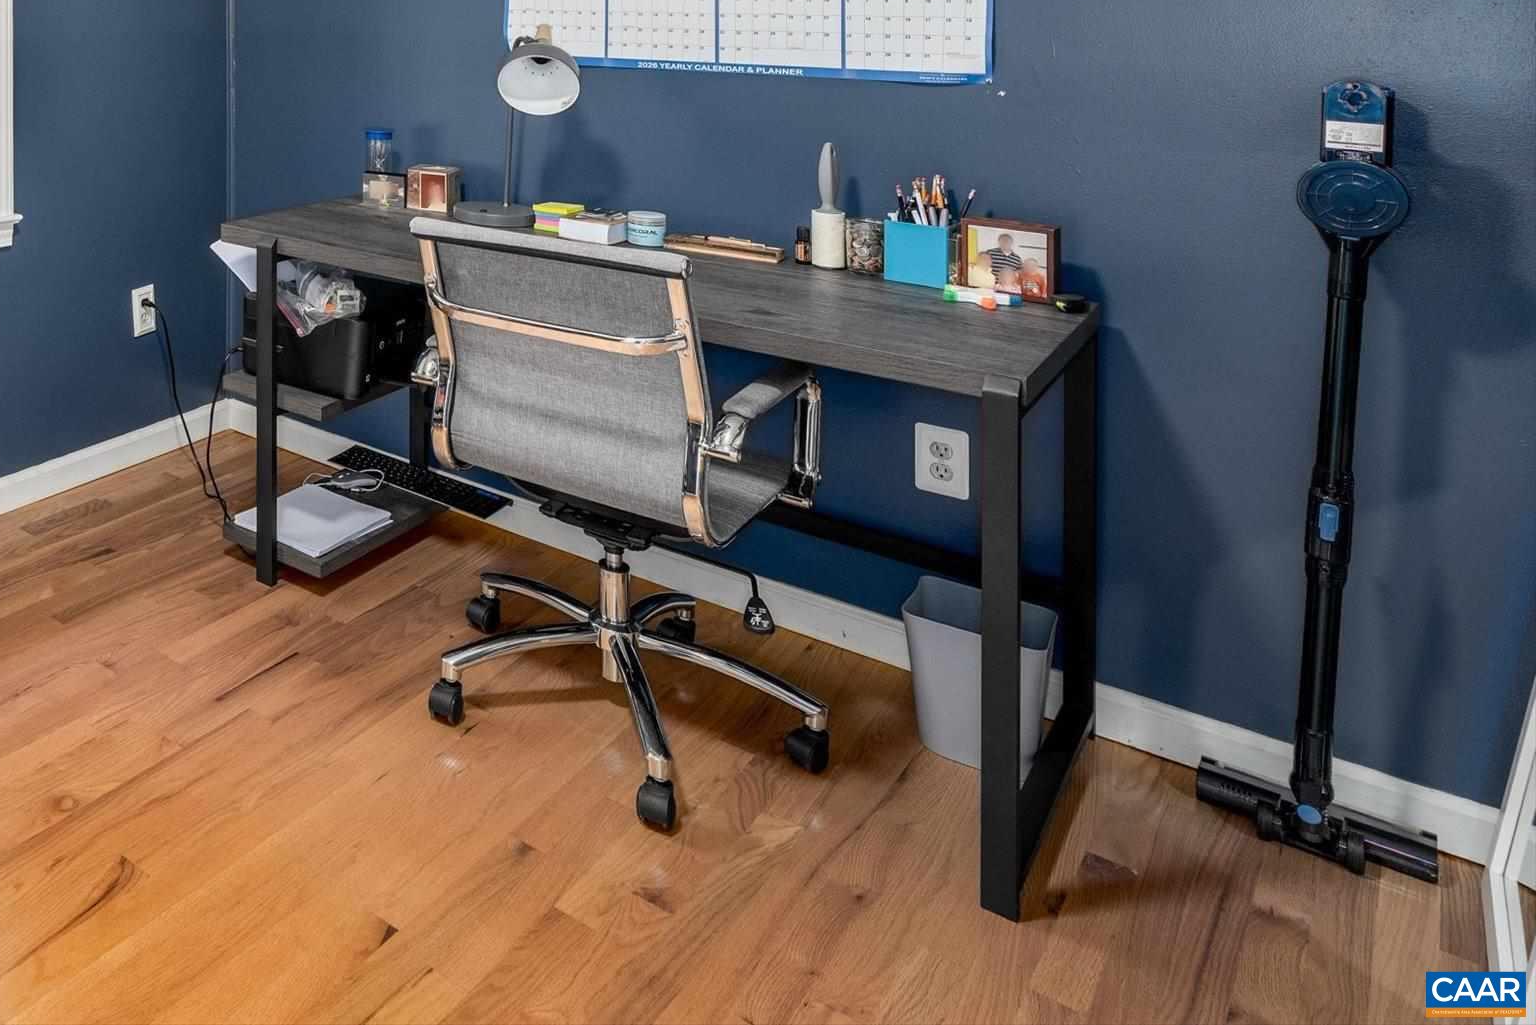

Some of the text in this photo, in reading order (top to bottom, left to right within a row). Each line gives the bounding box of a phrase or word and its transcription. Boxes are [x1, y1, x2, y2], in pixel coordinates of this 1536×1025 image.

[658, 63, 694, 71] YEARLY
[695, 64, 745, 73] CALENDAR
[756, 67, 804, 76] PLANNER
